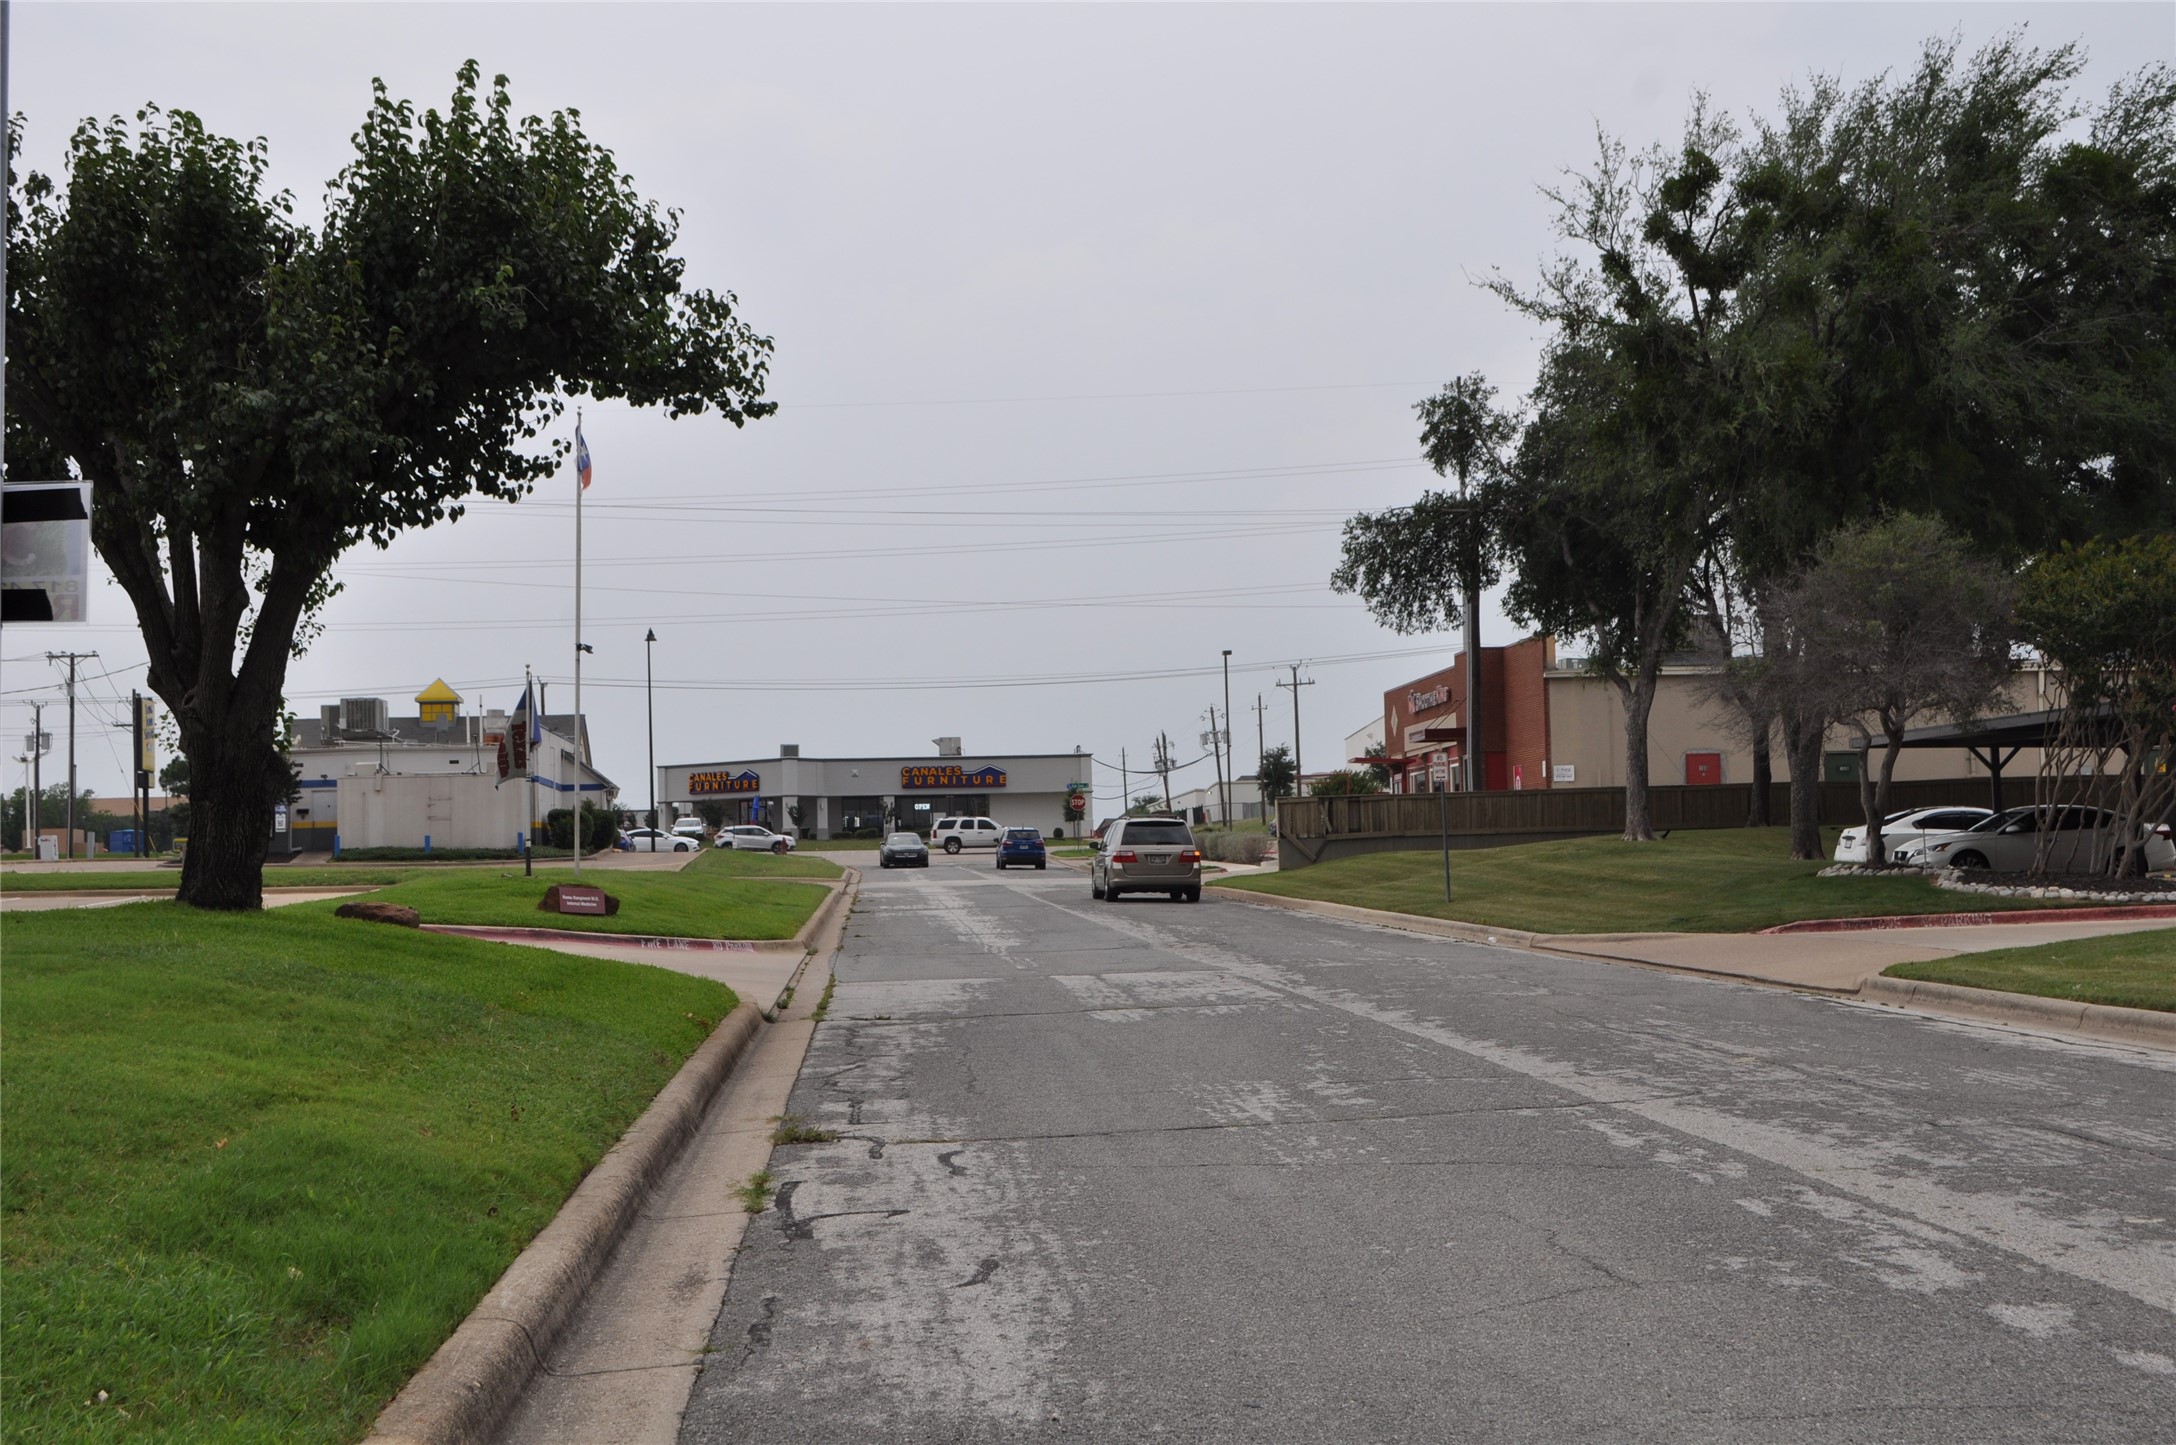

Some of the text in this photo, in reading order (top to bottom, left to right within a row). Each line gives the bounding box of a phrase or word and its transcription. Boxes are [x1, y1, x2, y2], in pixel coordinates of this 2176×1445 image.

[902, 766, 961, 776] CANALES
[689, 772, 728, 782] CANALES
[902, 775, 1006, 786] FURNITURE
[688, 779, 758, 791] FURNITURE
[1071, 798, 1084, 806] STOP
[666, 939, 690, 950] LANE
